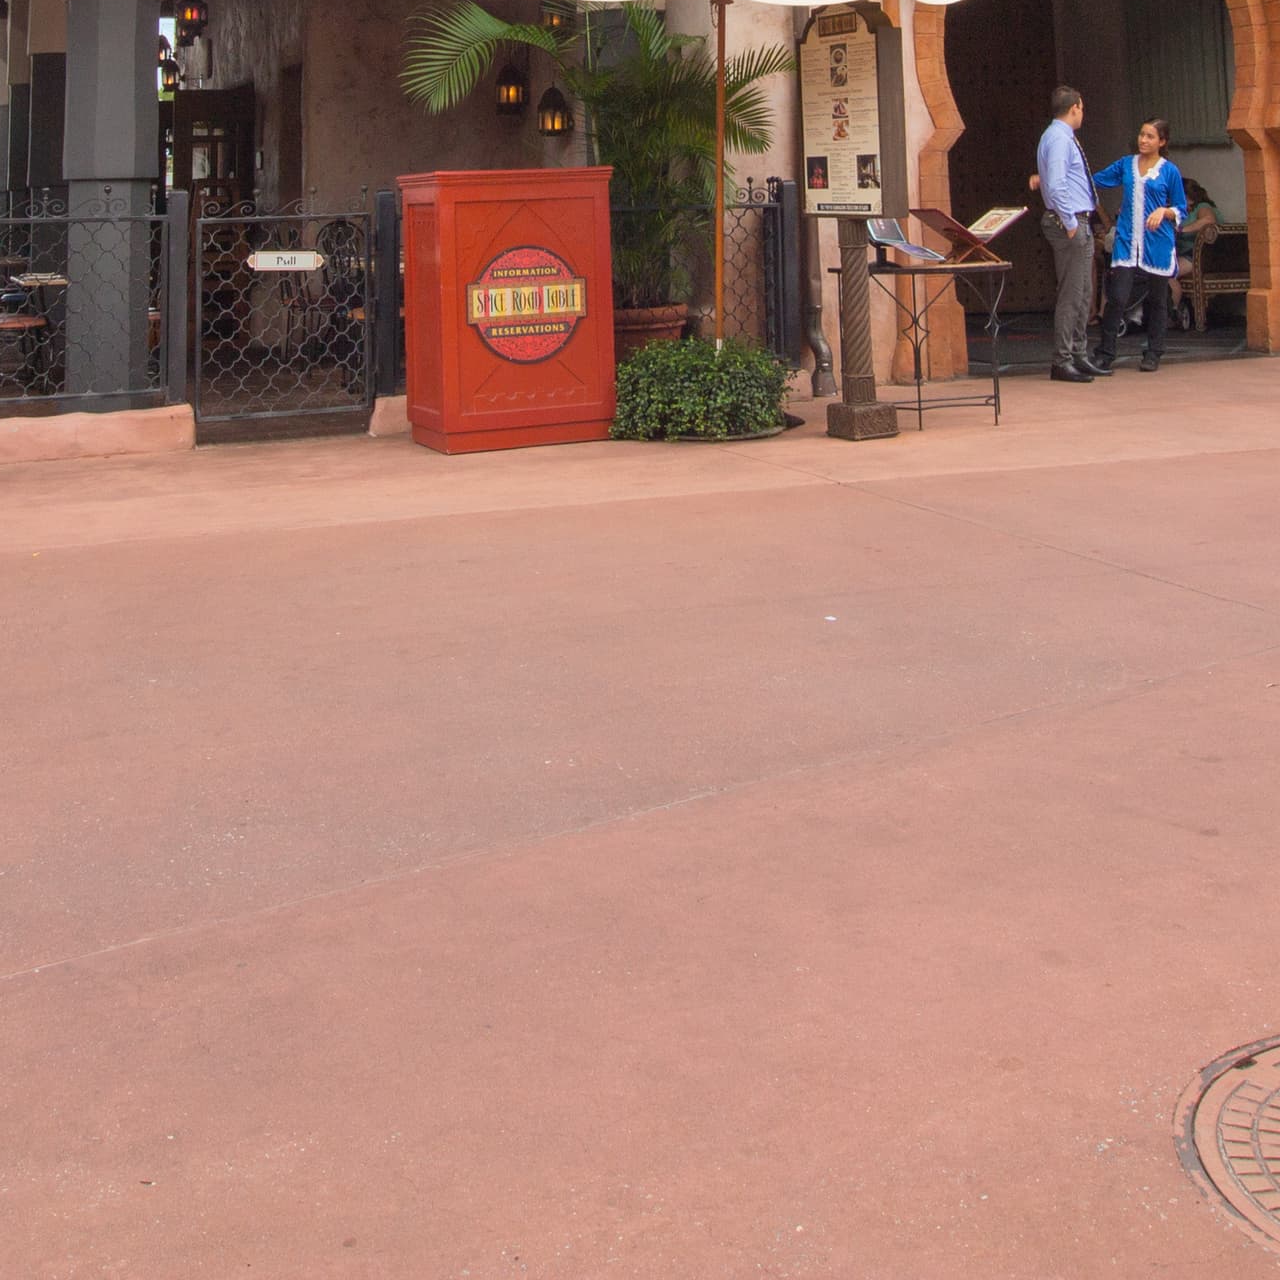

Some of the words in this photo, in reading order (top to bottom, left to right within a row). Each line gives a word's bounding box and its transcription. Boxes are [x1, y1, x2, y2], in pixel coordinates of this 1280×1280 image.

[276, 255, 296, 265] Pull
[493, 267, 558, 278] INFORMATION
[477, 291, 505, 314] SPICE
[512, 290, 542, 313] ROAD
[545, 287, 577, 309] TABLE
[491, 323, 565, 337] RESERVATIONS
